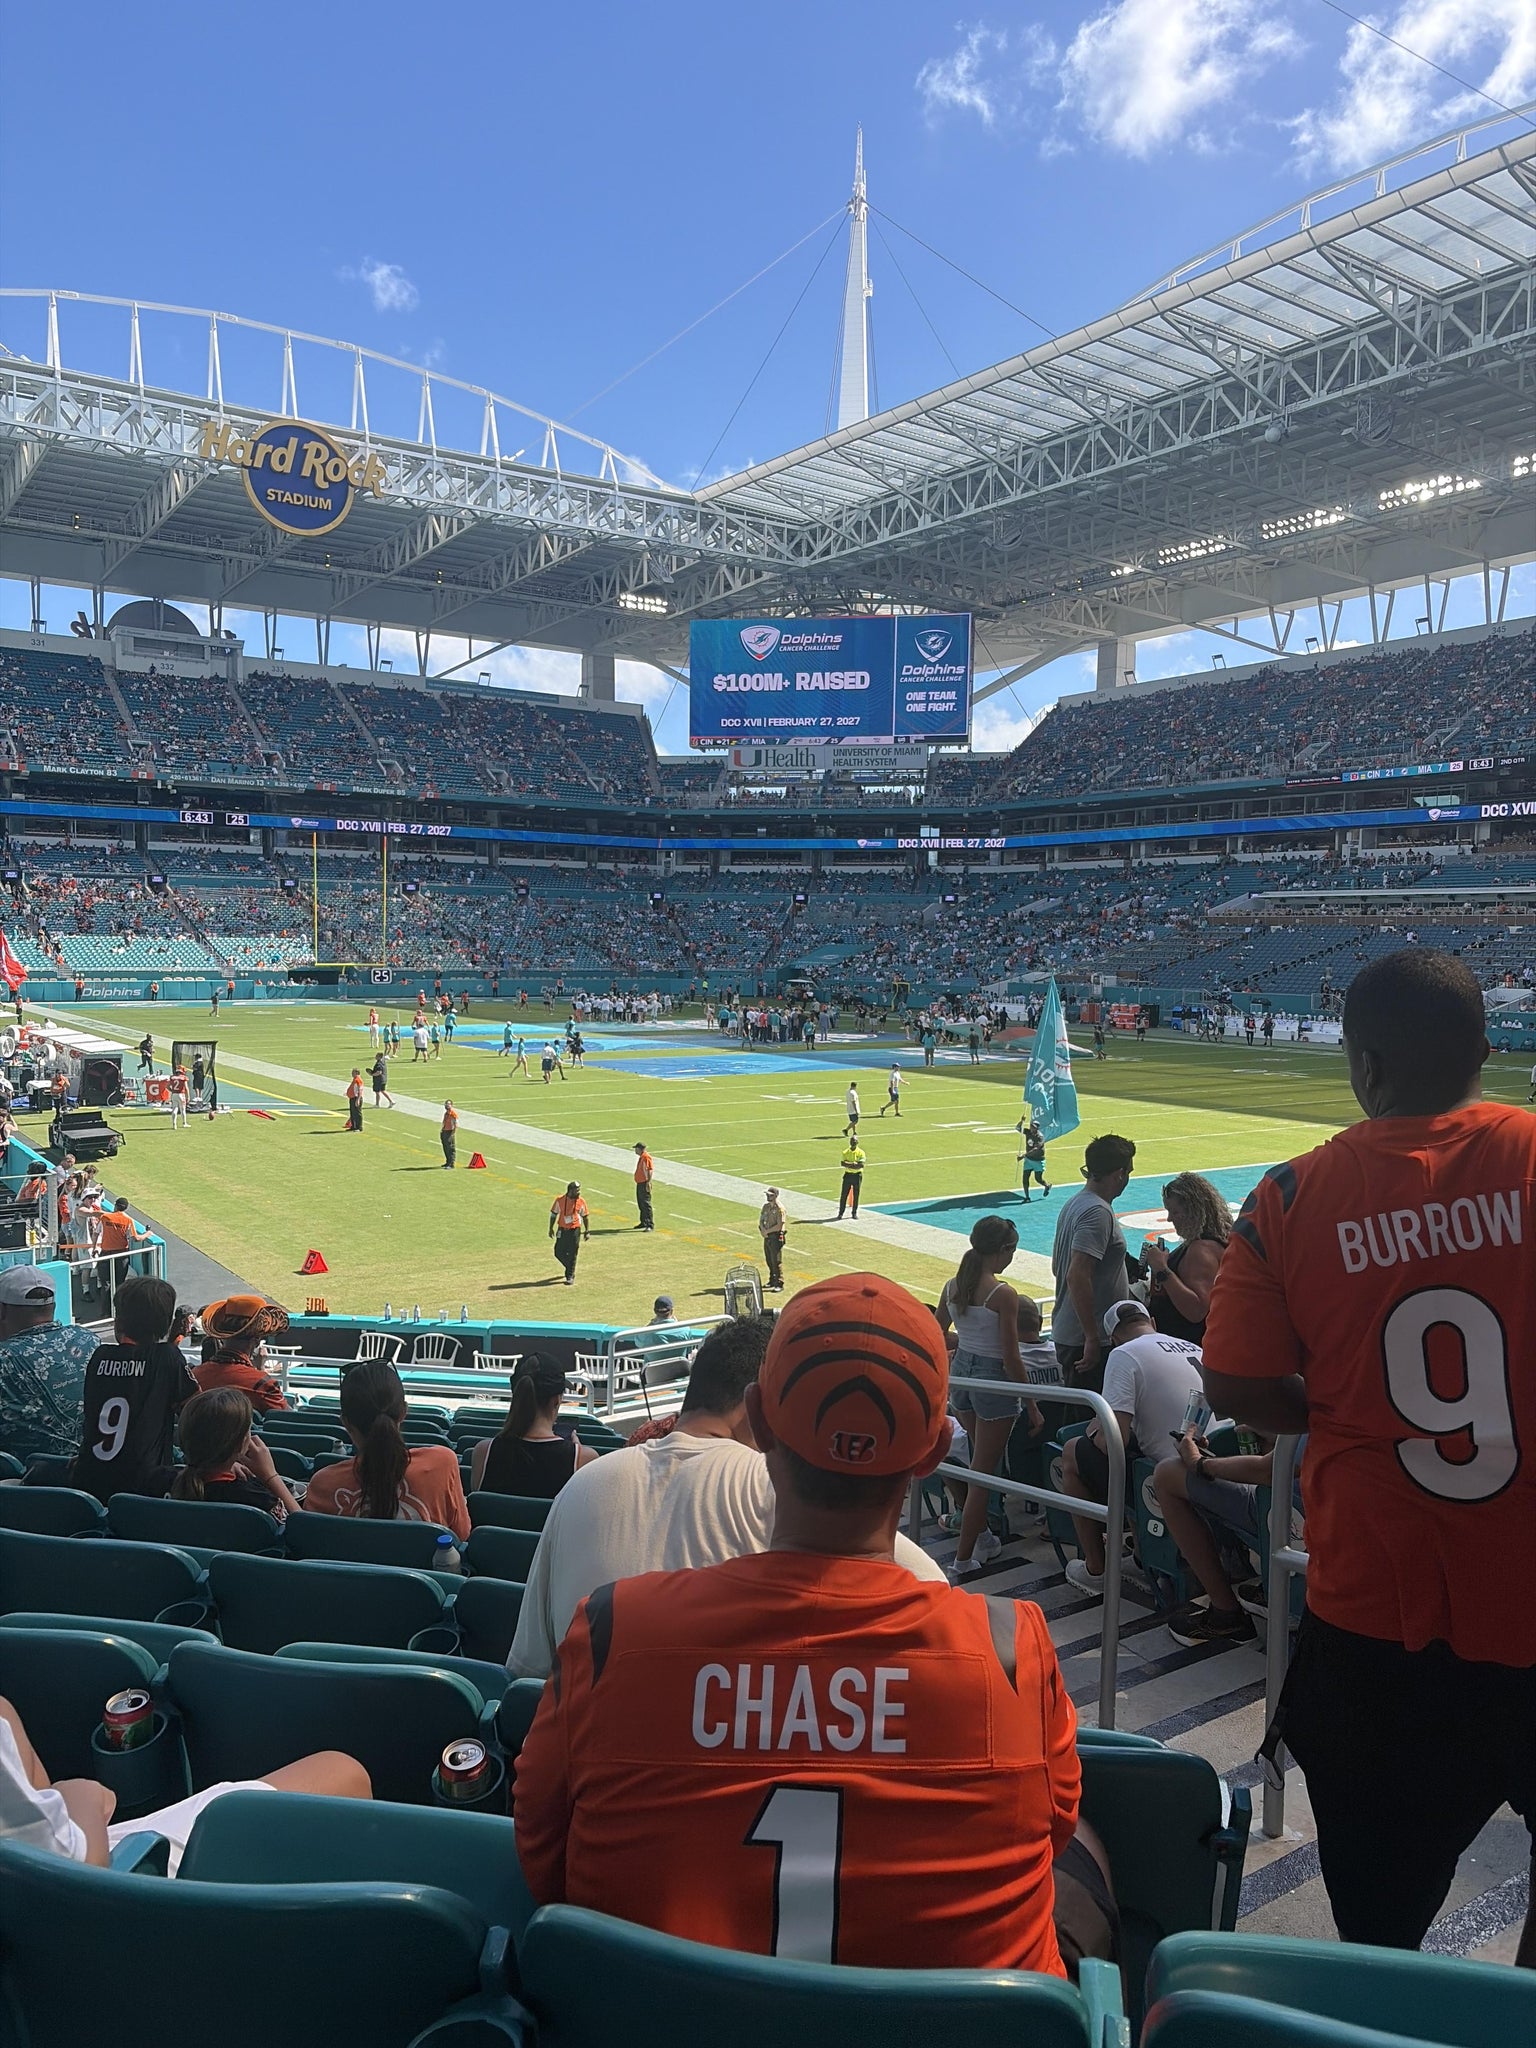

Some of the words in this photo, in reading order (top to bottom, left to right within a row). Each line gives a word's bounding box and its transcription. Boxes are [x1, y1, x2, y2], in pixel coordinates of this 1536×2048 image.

[200, 421, 299, 474] Hard
[301, 440, 386, 498] Rock
[266, 488, 332, 511] STADIUM
[1492, 626, 1506, 635] 345
[31, 638, 45, 647] 331
[780, 632, 843, 647] Dolphins
[804, 644, 841, 652] CHALLENGE
[160, 662, 175, 671] 332
[271, 665, 285, 673] 333
[901, 664, 966, 677] Dolphins
[712, 673, 791, 692] $100M+
[795, 671, 871, 691] RAISED
[925, 675, 963, 683] CHALLENGE
[905, 692, 926, 701] ONE
[927, 691, 957, 701] TEAM.
[905, 703, 926, 712] ONE
[927, 702, 957, 712] FIGHT.
[720, 717, 741, 727] DCC
[743, 717, 762, 727] XVII
[768, 717, 817, 727] FEBRUARY
[820, 717, 834, 727] 27,
[836, 716, 861, 726] 2027
[833, 748, 879, 757] UNIVERSITY
[880, 748, 892, 757] OF
[893, 747, 922, 756] MIAMI
[833, 758, 864, 767] HEALTH
[864, 757, 897, 766] SYSTEM
[1473, 760, 1489, 768] 6:43
[43, 765, 68, 773] MARK
[69, 766, 104, 776] CLAYTON
[1367, 770, 1380, 779] CIN
[1418, 766, 1433, 774] MIA
[227, 778, 255, 786] MARINO
[1481, 803, 1509, 818] DCC
[184, 812, 209, 823] 6:43
[231, 815, 245, 825] 25
[336, 819, 359, 830] DCC
[362, 820, 381, 832] XVII
[387, 823, 408, 834] FEB.
[410, 824, 425, 835] 27,
[427, 825, 452, 836] 2027
[898, 838, 918, 848] DCC
[920, 838, 940, 848] XVII
[945, 838, 965, 848] FEB.
[967, 838, 982, 849] 27,
[984, 838, 1006, 848] 2027
[374, 970, 390, 982] 25
[82, 987, 142, 998] Dolphins
[148, 1084, 160, 1096] G
[173, 1080, 180, 1091] 2
[1336, 1189, 1523, 1275] BURROW
[97, 1359, 147, 1377] BURROW
[1381, 1285, 1523, 1504] 9
[92, 1396, 130, 1461] 9
[1152, 1523, 1159, 1533] 8
[692, 1662, 910, 1754] CHASE
[742, 1781, 845, 1965] 1
